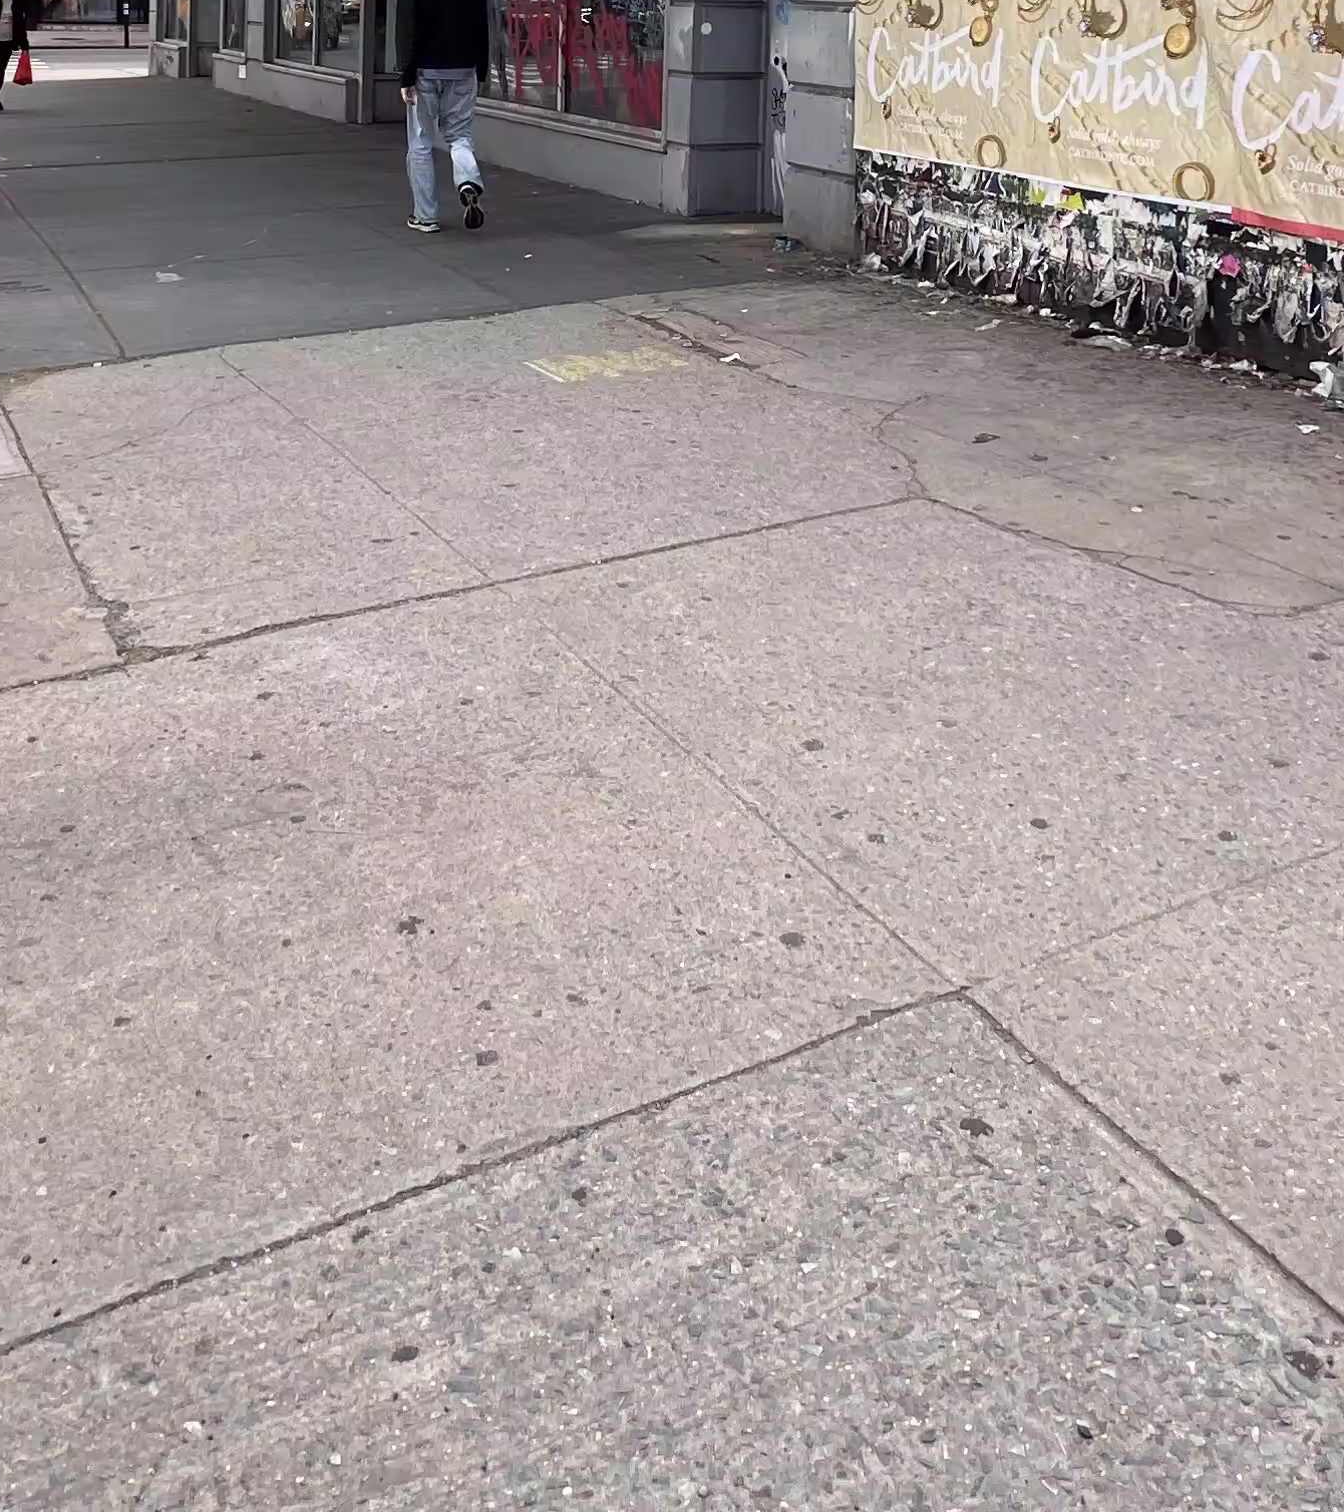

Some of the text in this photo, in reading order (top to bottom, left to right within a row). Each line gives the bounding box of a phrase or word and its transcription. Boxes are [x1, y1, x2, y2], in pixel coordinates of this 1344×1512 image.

[867, 25, 1003, 108] Catbird
[1030, 34, 1208, 130] Catbird
[1286, 155, 1323, 175] Solid
